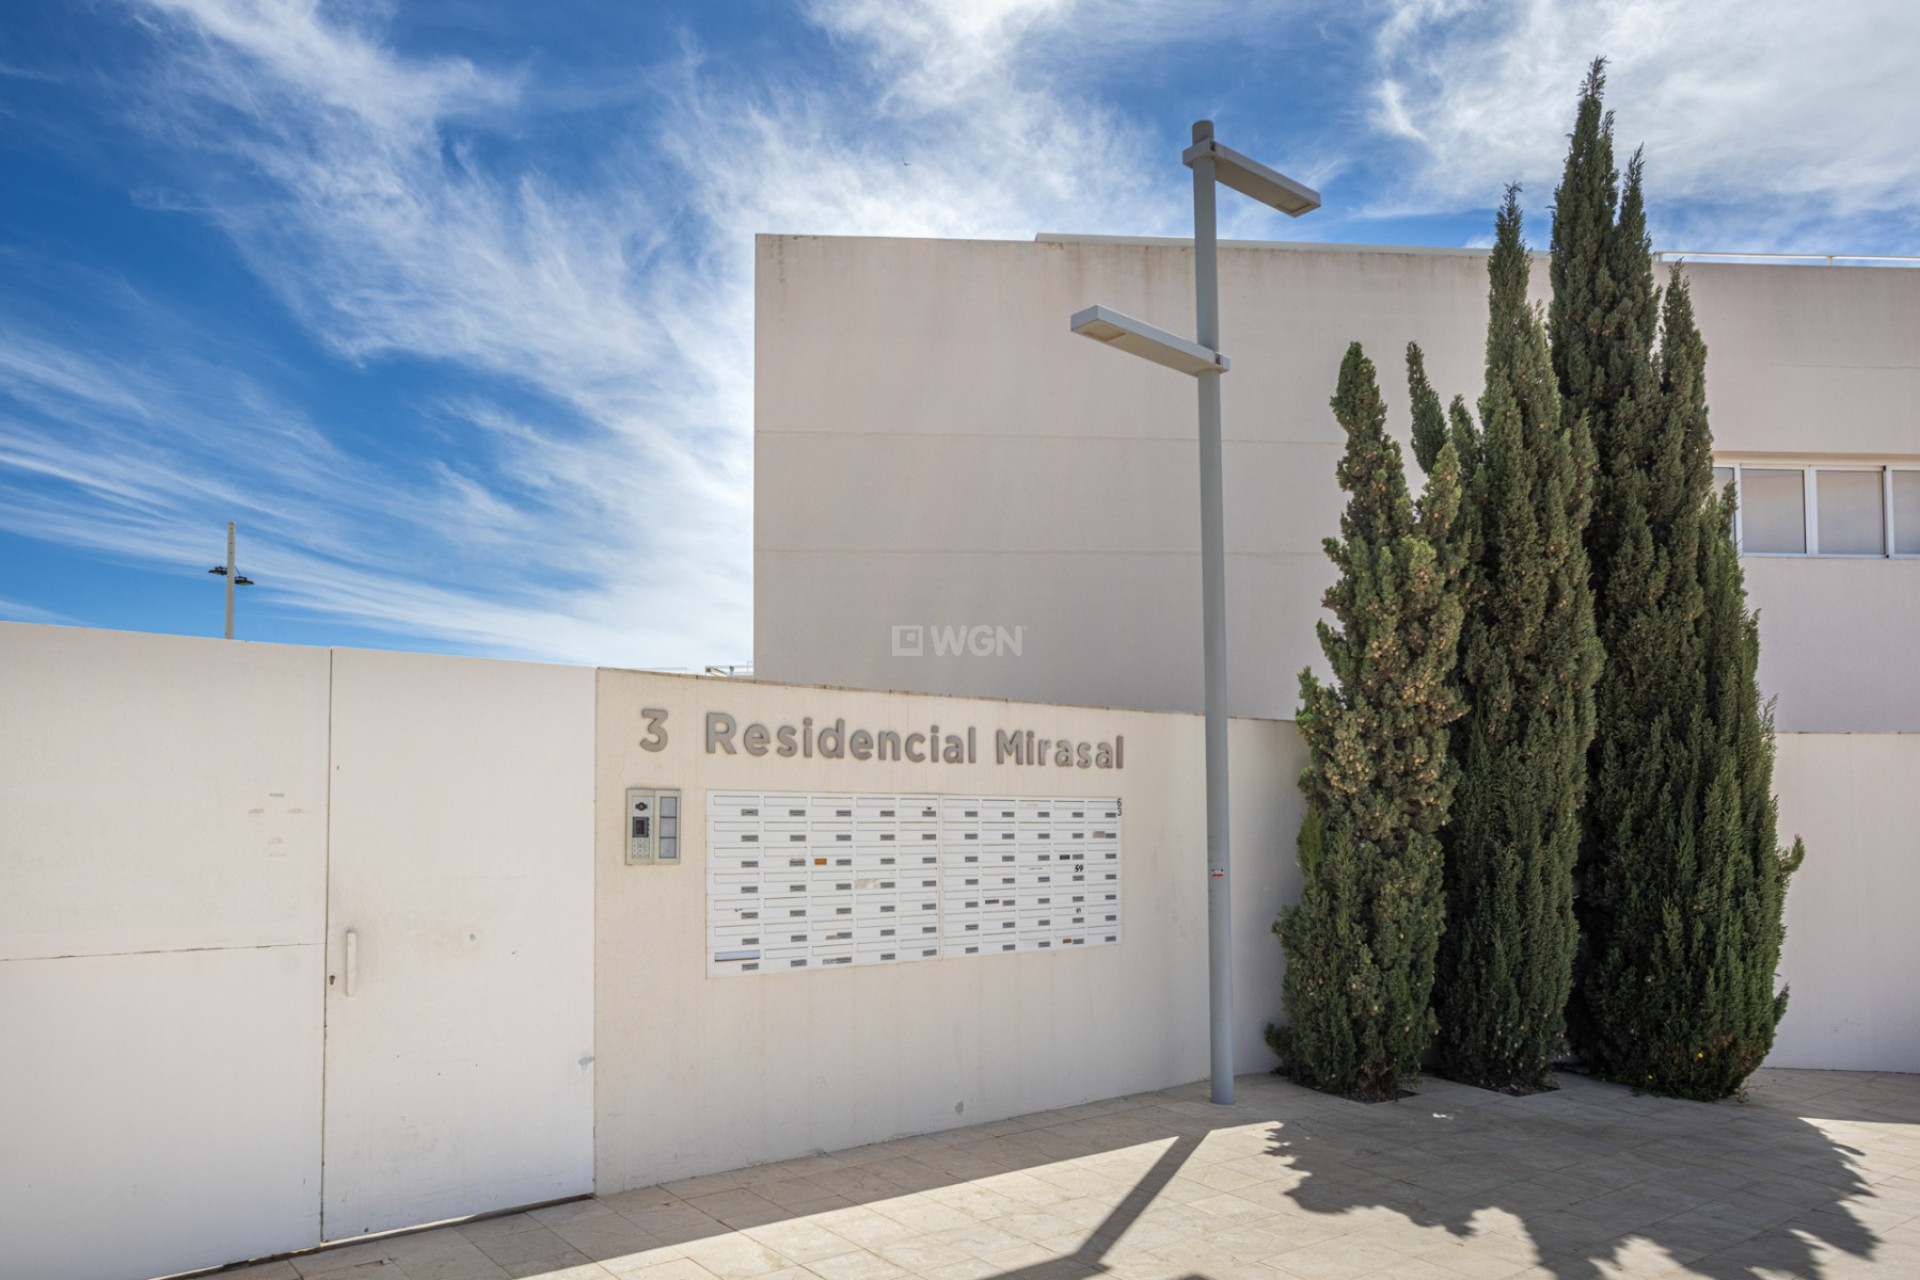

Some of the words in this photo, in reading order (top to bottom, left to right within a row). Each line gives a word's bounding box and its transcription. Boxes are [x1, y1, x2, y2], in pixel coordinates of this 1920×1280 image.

[639, 708, 669, 752] 3
[706, 712, 976, 763] Residencial
[995, 729, 1124, 770] Mirasal
